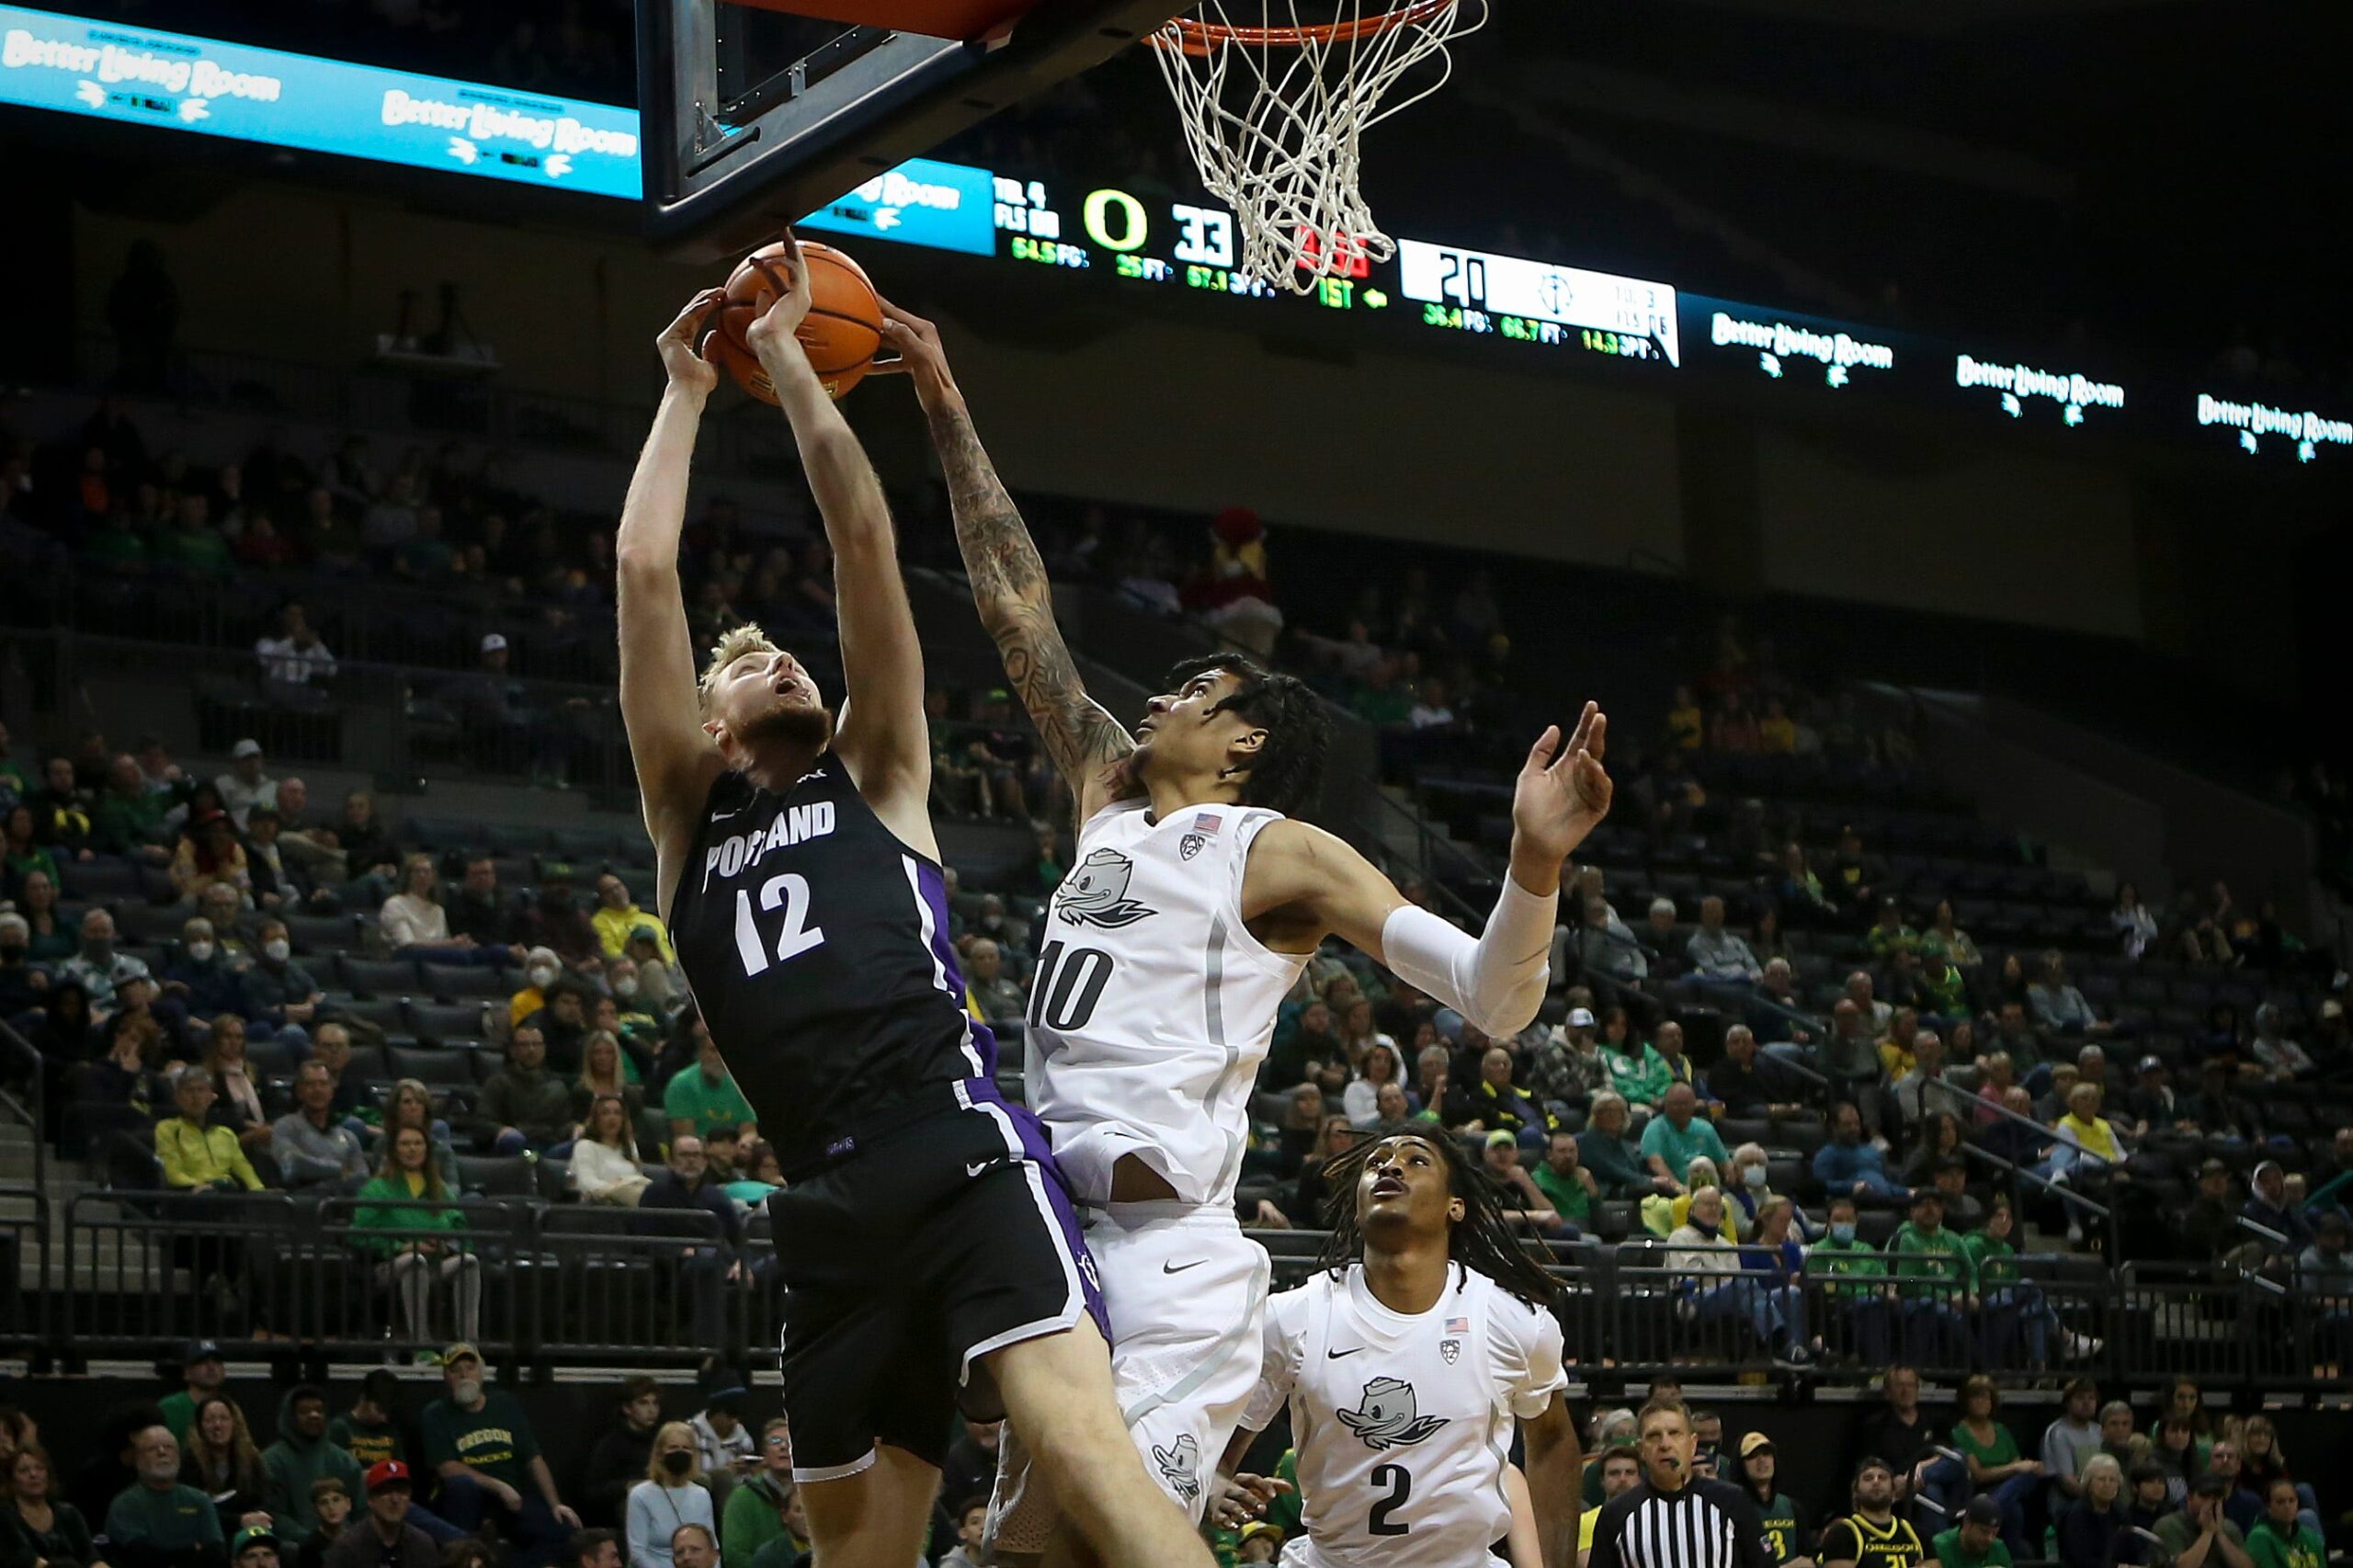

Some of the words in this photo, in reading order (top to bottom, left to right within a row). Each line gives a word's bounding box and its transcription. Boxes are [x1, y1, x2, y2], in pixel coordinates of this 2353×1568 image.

[3, 29, 100, 73] Better
[97, 45, 191, 92] Living
[190, 60, 281, 102] Room
[381, 89, 471, 130] Better
[469, 103, 554, 149] Living
[552, 118, 637, 157] Room
[882, 172, 960, 210] Room
[1084, 188, 1147, 251] O
[1172, 203, 1233, 267] 33
[1439, 253, 1486, 310] 20
[1711, 312, 1775, 349] Better
[1773, 322, 1835, 363] Living
[1834, 333, 1893, 369] Room
[1956, 354, 2015, 390] Better
[2014, 363, 2069, 403] Living
[2069, 373, 2124, 407] Room
[2198, 393, 2252, 427] Better
[2251, 402, 2302, 440] Living
[2302, 411, 2353, 444] Room
[735, 873, 824, 976] 12
[1030, 940, 1114, 1030] 10
[1369, 1464, 1411, 1536] 2
[1768, 1528, 1788, 1561] 3
